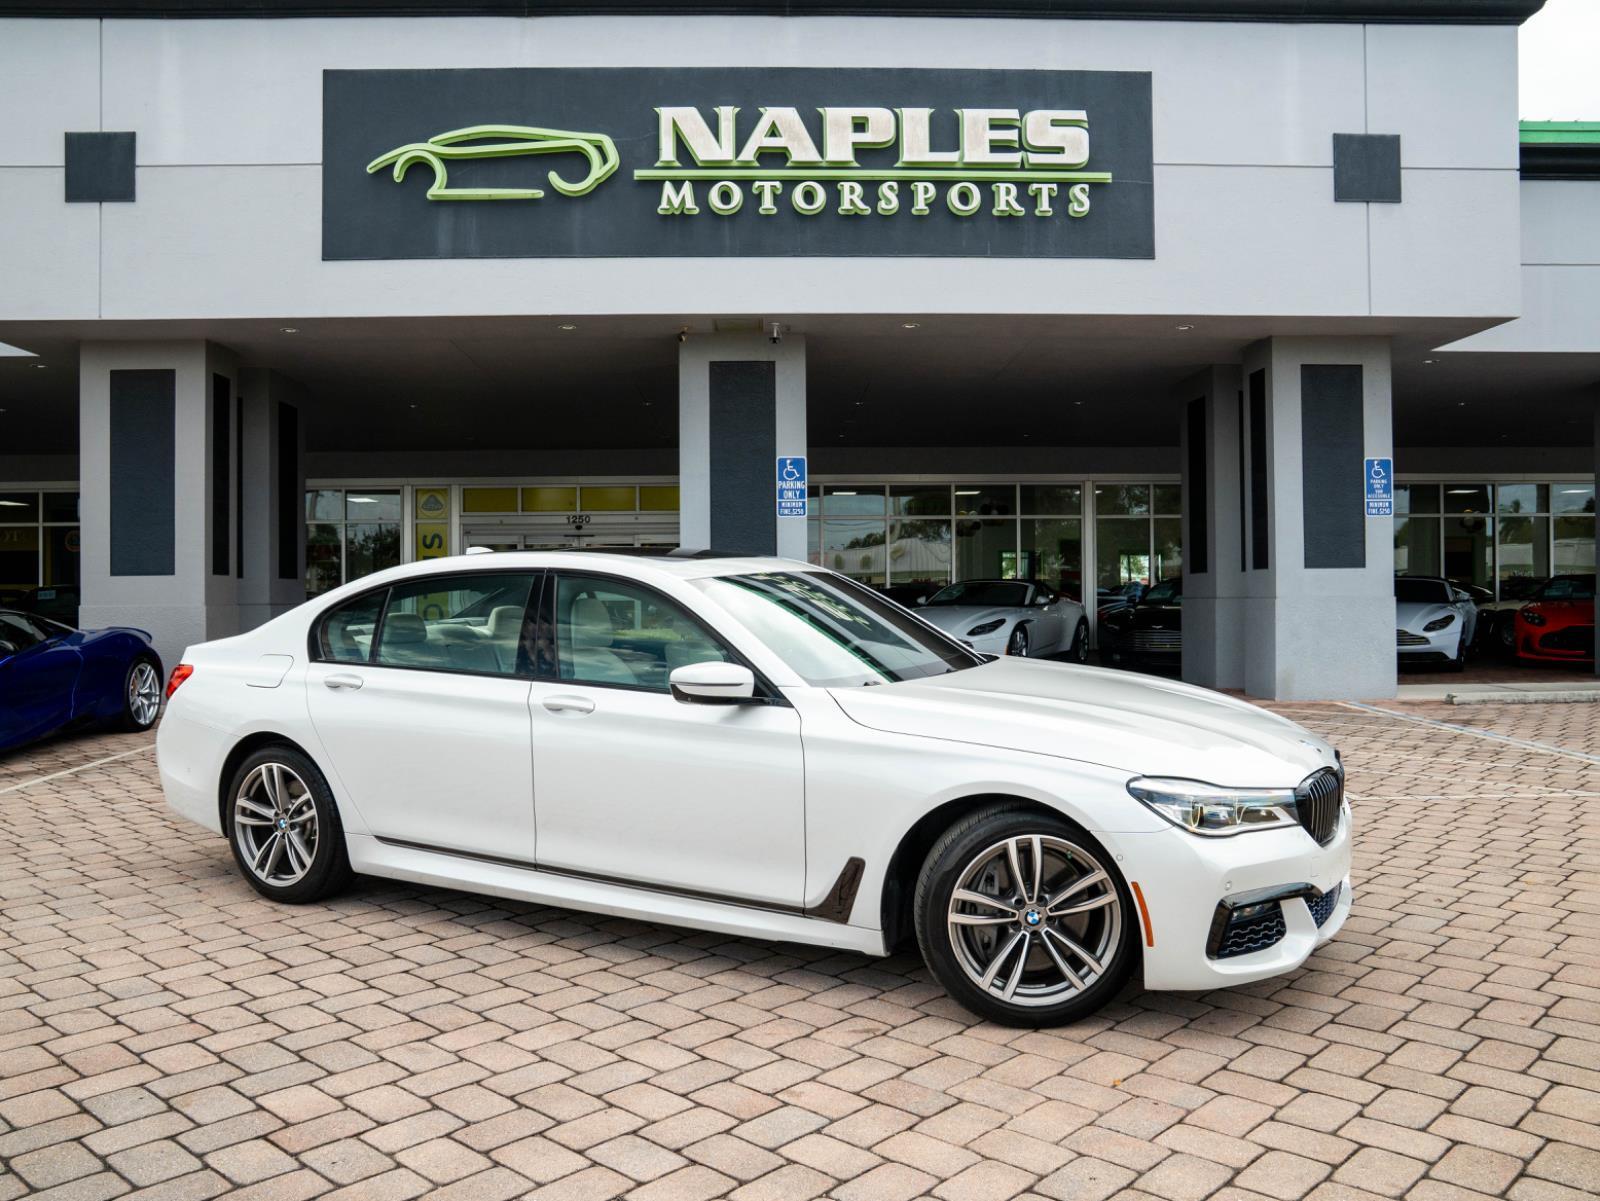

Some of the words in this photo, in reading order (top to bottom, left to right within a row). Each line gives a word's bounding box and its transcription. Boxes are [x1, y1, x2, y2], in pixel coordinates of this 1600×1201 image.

[652, 105, 1090, 169] NAPLES
[657, 180, 1091, 217] MOTORSPORTS
[778, 480, 805, 489] PARKING
[783, 490, 800, 499] ONLY
[566, 514, 591, 524] 1250
